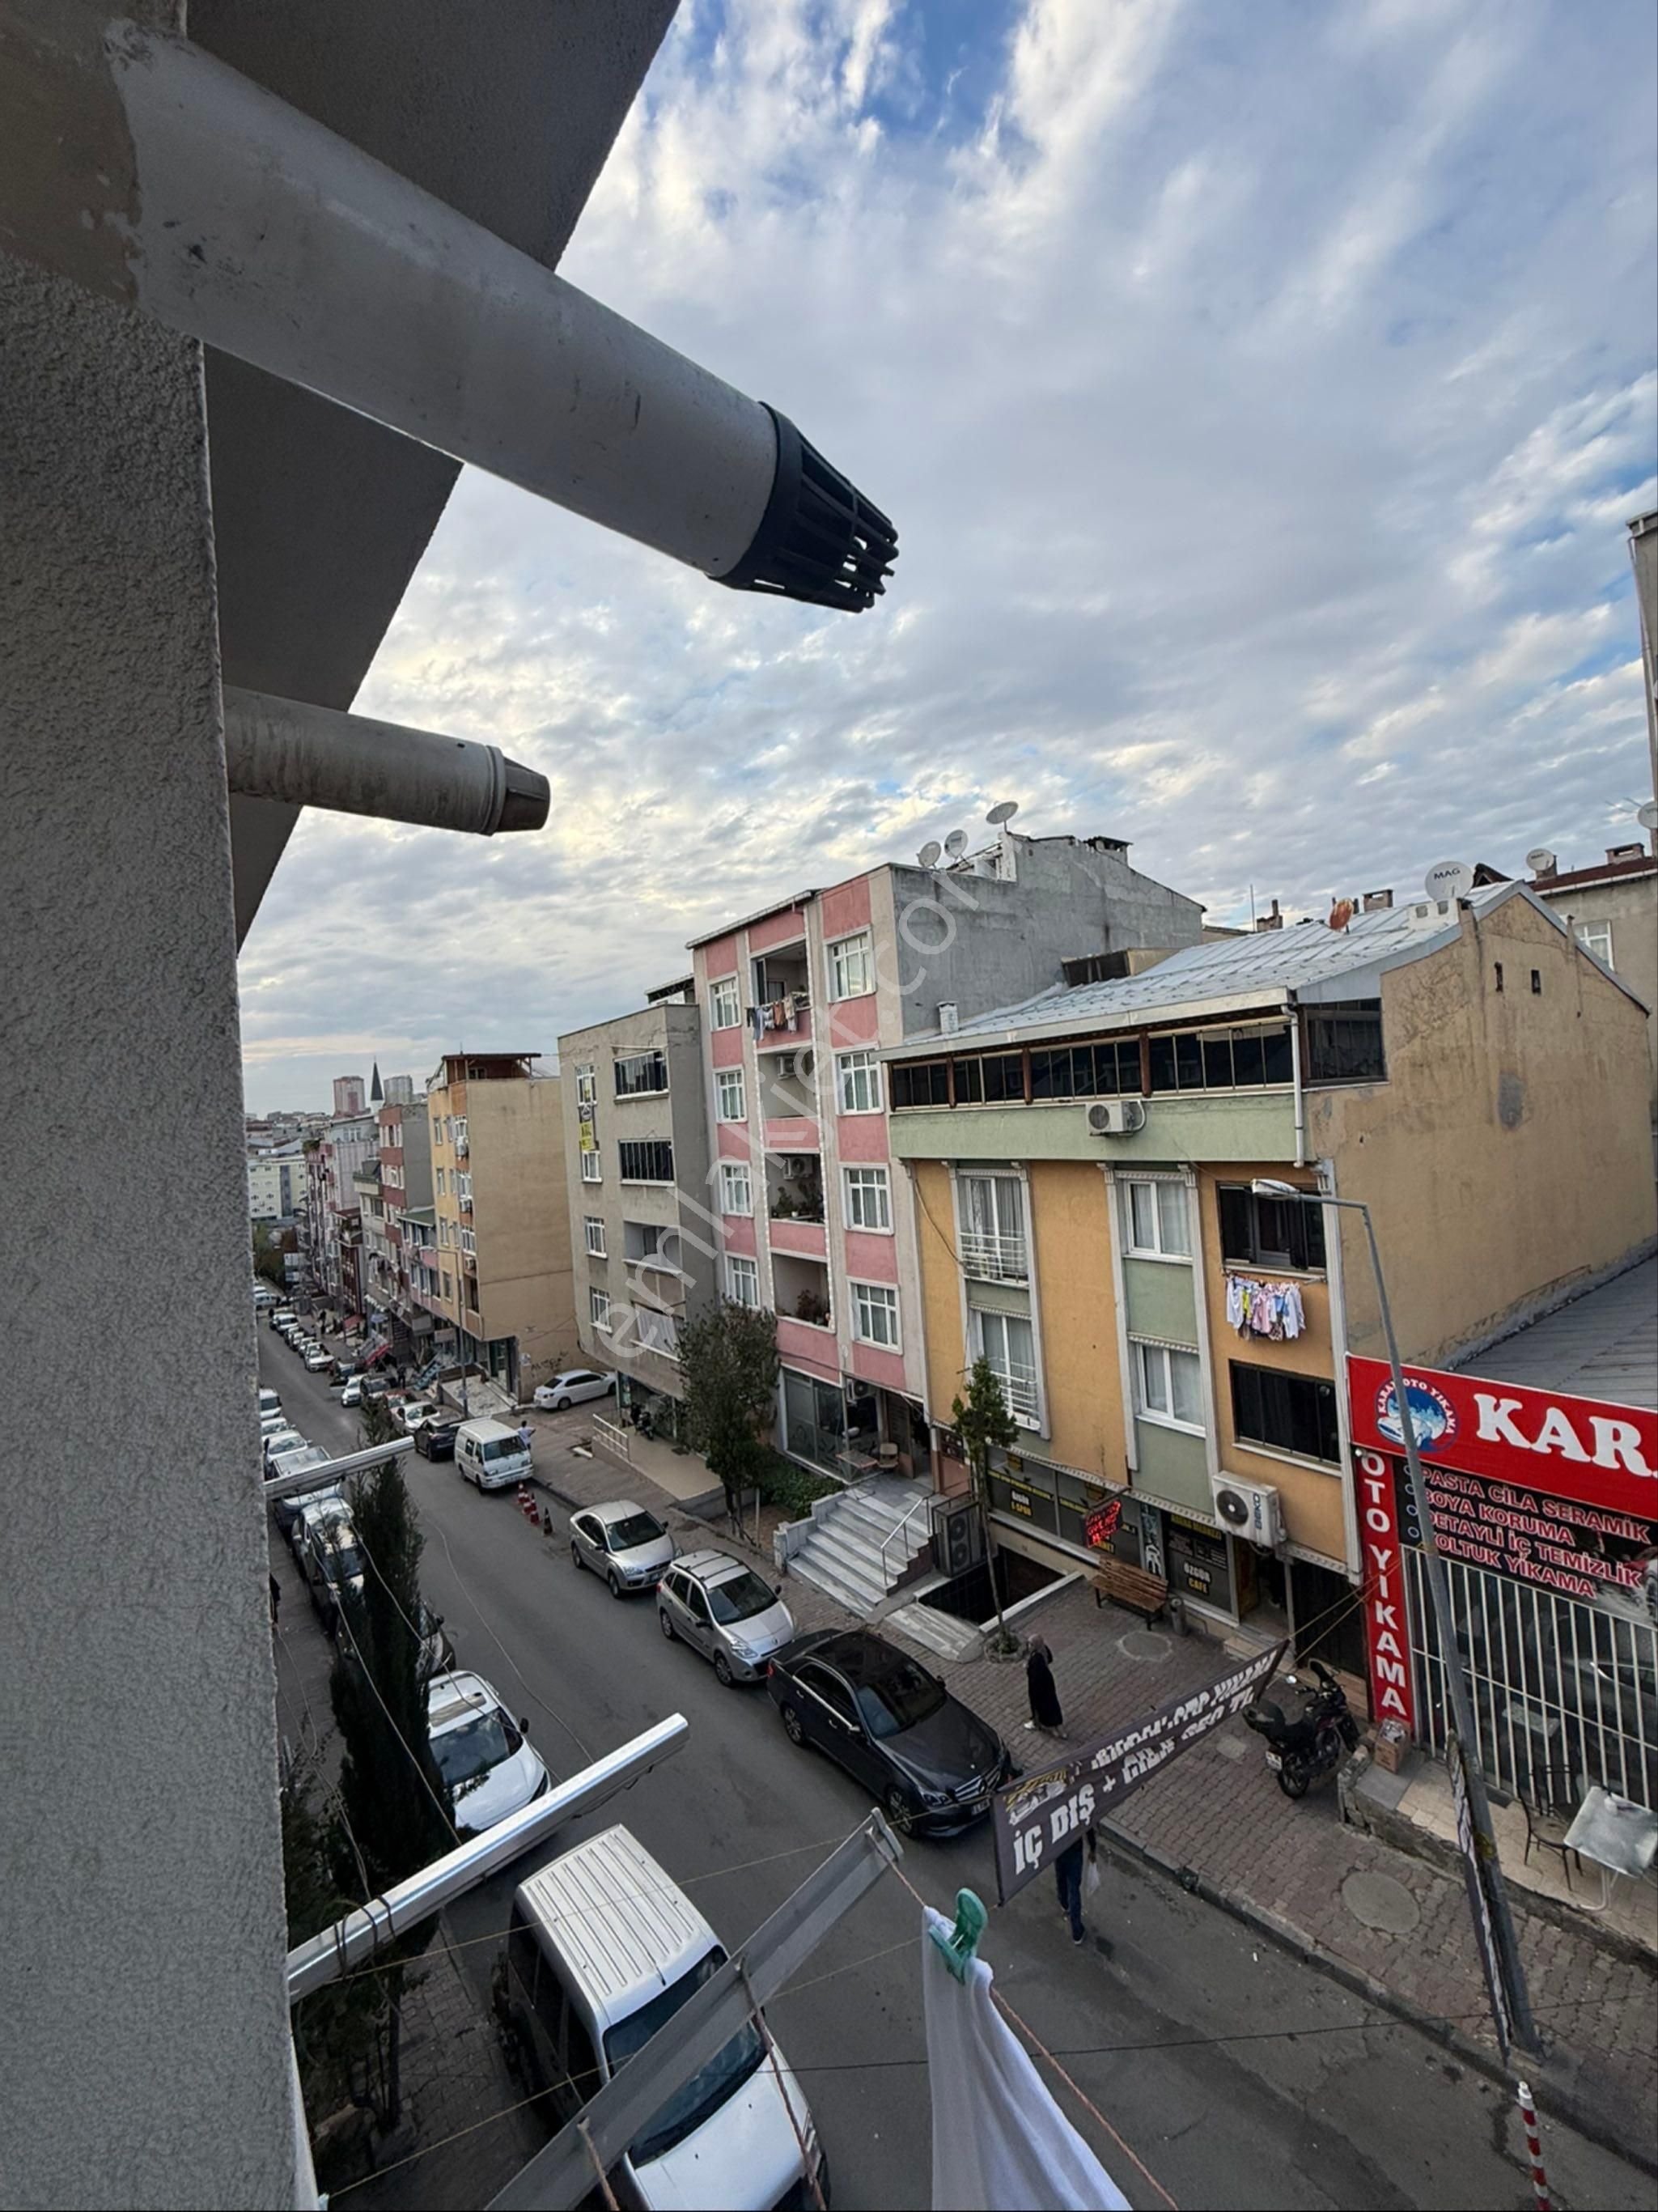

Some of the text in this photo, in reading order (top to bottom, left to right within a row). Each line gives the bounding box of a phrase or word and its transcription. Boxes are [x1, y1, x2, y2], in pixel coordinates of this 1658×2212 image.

[1434, 867, 1461, 881] MAG
[1402, 1378, 1427, 1390] OTO
[1421, 1467, 1652, 1544] PASTA CİLA SERAMİK
[1479, 1503, 1575, 1547] KORUMA
[1434, 1532, 1502, 1569] OLTUK
[1508, 1529, 1531, 1559] İÇ
[1534, 1540, 1643, 1590] TEMİZLİK
[1361, 1452, 1407, 1716] OTO YIKAMA
[1013, 1824, 1043, 1875] İÇ
[1050, 1783, 1096, 1844] DIŞ
